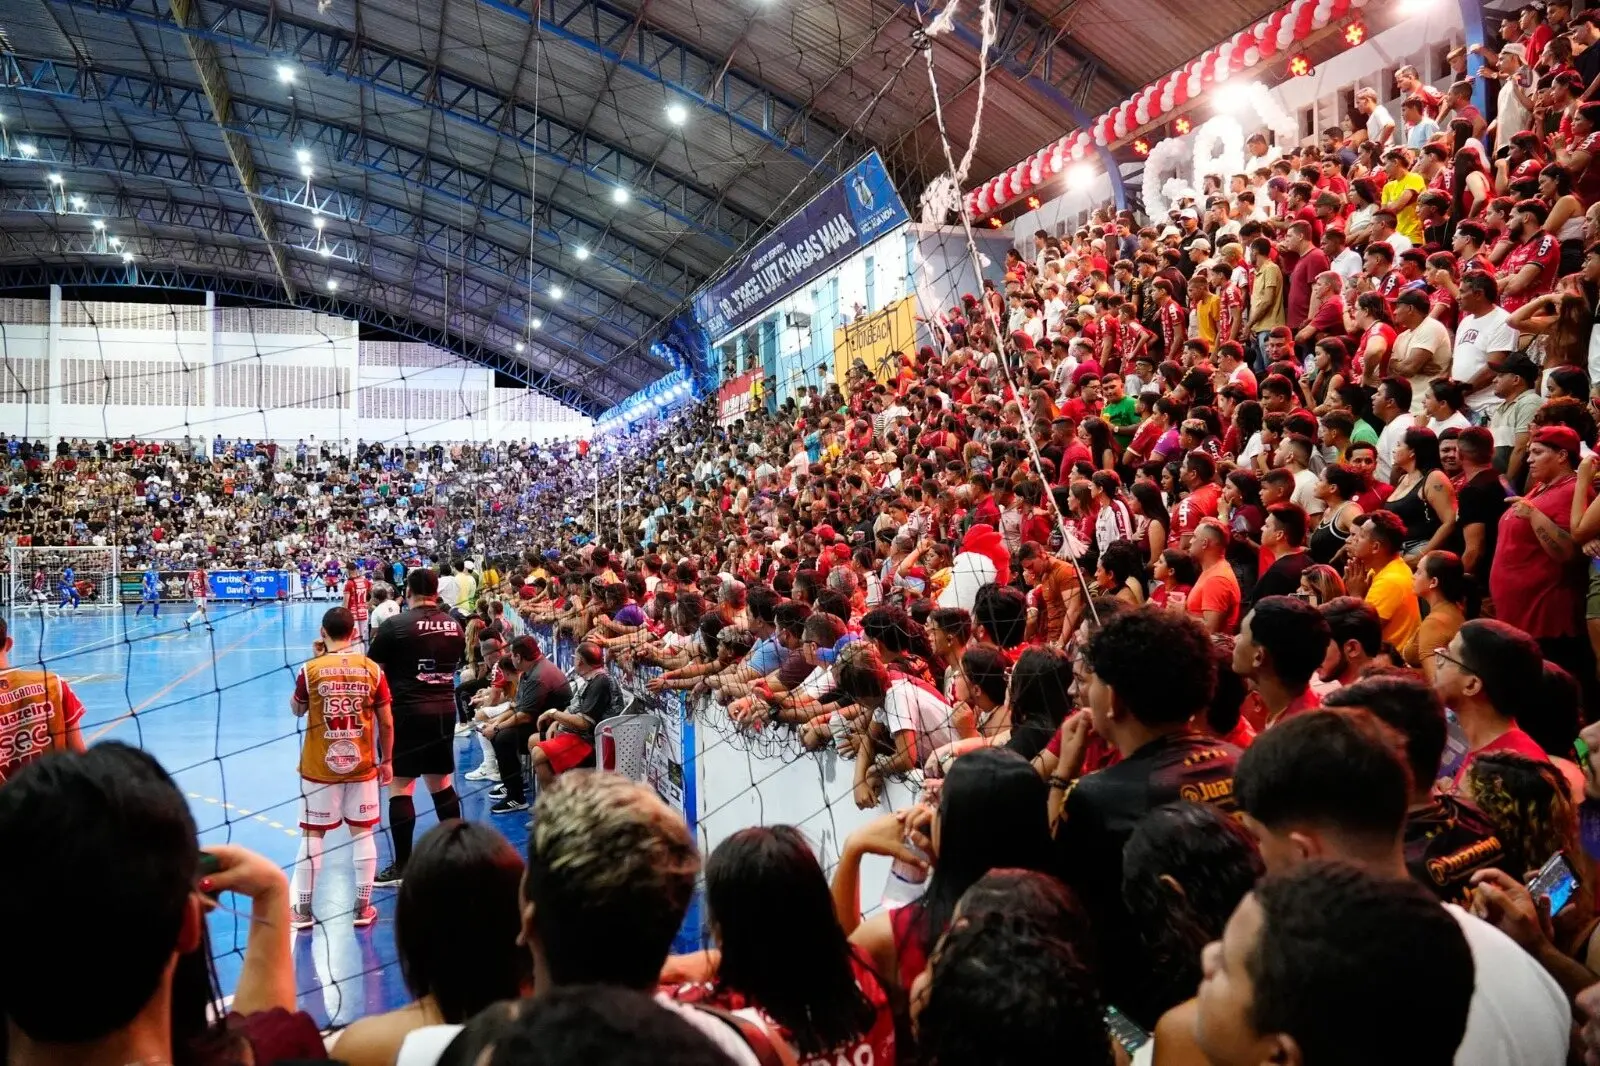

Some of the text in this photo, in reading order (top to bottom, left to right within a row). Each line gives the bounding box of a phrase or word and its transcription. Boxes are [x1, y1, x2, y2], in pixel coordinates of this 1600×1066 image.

[719, 298, 739, 320] DR.
[731, 277, 764, 312] JORGE
[756, 262, 785, 295] LUIZ
[778, 234, 824, 280] CHAGAS
[816, 213, 857, 254] MAIA
[416, 621, 457, 631] TILLER
[0, 702, 52, 726] uazeir
[324, 717, 364, 731] WL
[0, 724, 51, 757] sec
